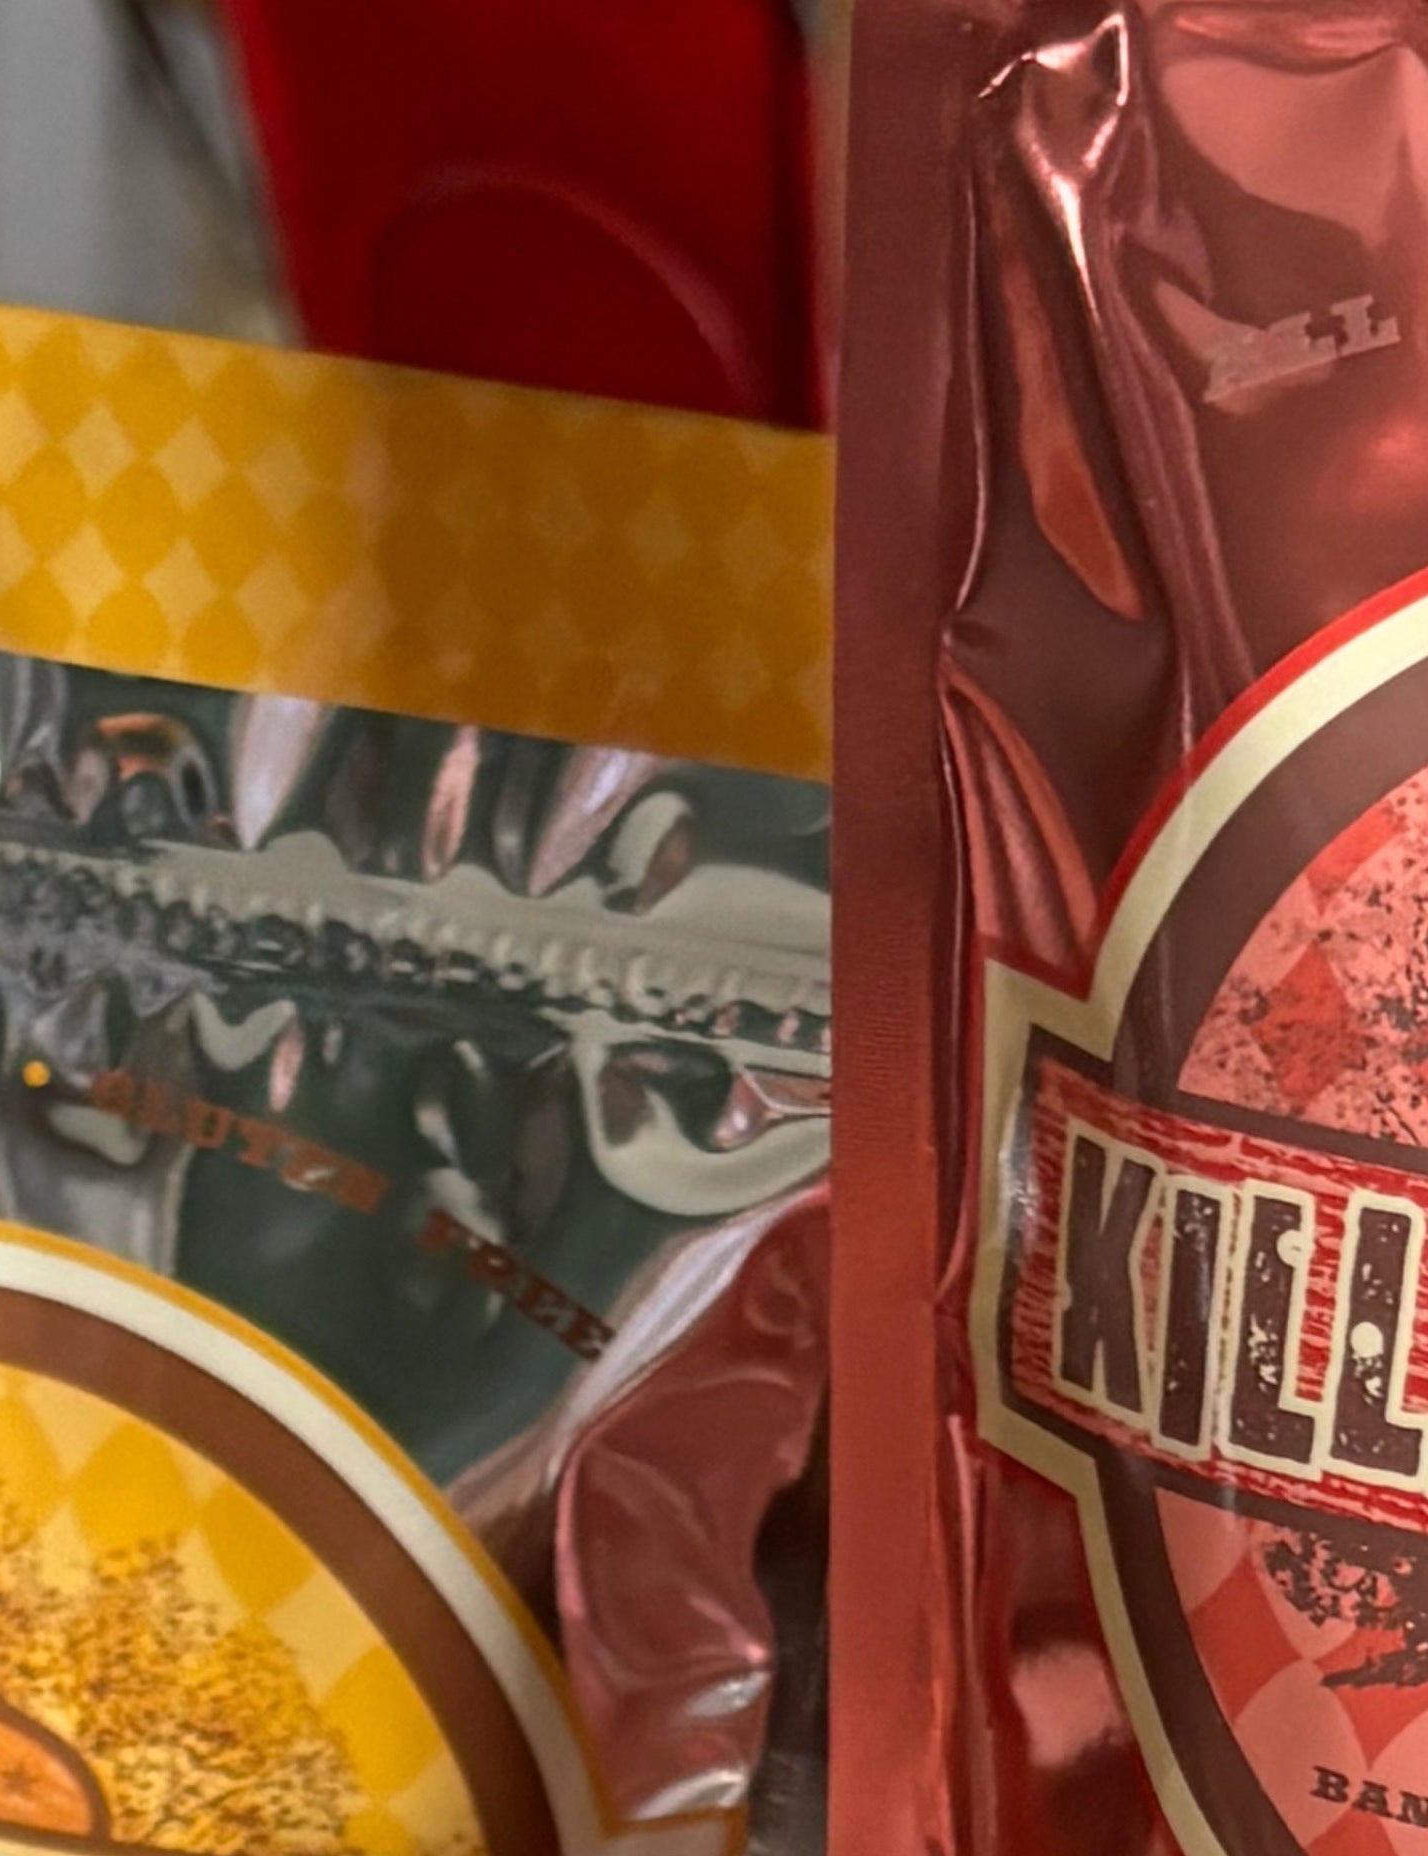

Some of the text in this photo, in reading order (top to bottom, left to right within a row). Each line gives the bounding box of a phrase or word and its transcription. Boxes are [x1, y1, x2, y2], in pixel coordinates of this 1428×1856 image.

[1204, 293, 1401, 402] ALL
[89, 1070, 392, 1214] GLUTEN
[415, 1208, 618, 1361] FREE
